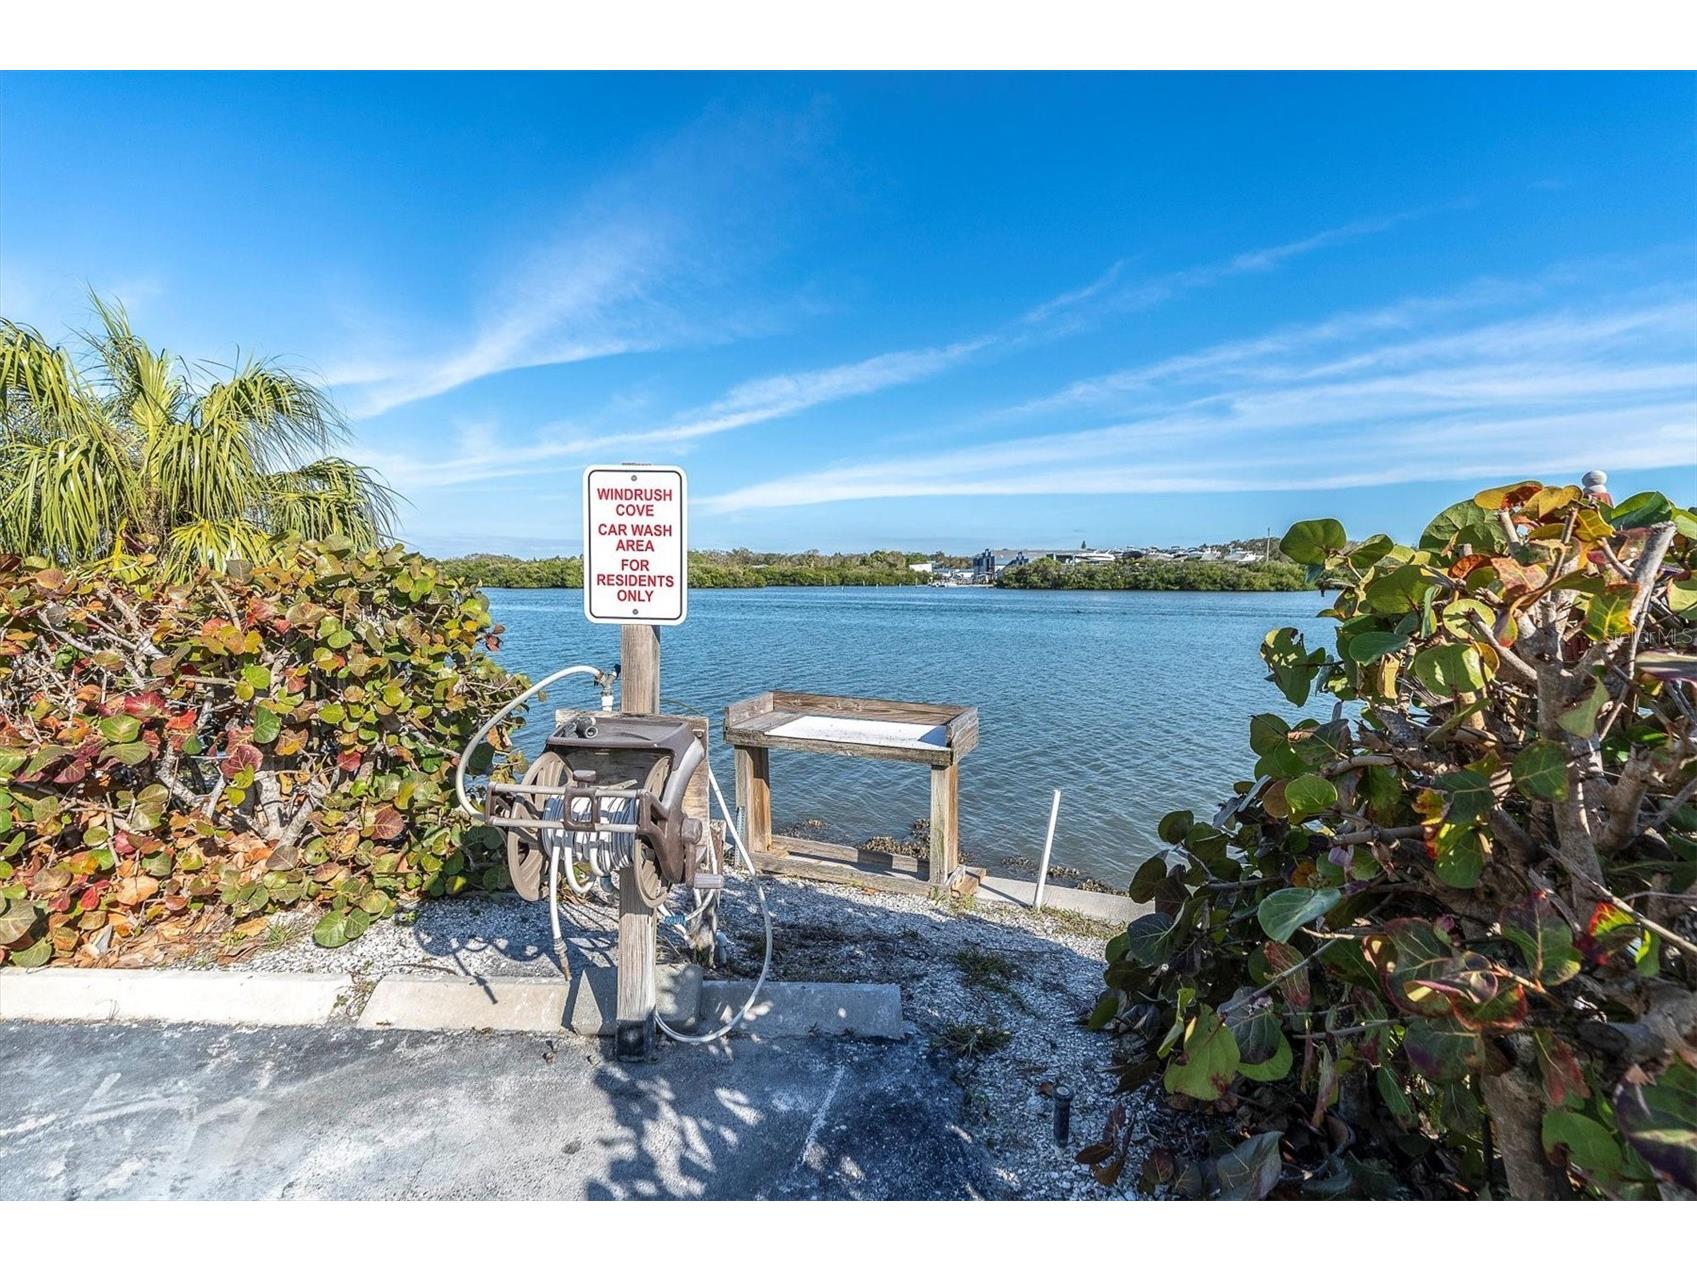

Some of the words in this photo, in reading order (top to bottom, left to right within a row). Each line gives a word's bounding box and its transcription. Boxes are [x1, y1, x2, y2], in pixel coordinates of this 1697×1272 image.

[597, 488, 673, 501] WINDRUSH
[616, 504, 654, 517] COVE
[598, 523, 627, 536] CAR
[631, 524, 673, 537] WASH
[615, 539, 655, 552] AREA
[621, 559, 650, 572] FOR
[596, 574, 674, 588] RESIDENTS
[616, 589, 654, 602] ONLY
